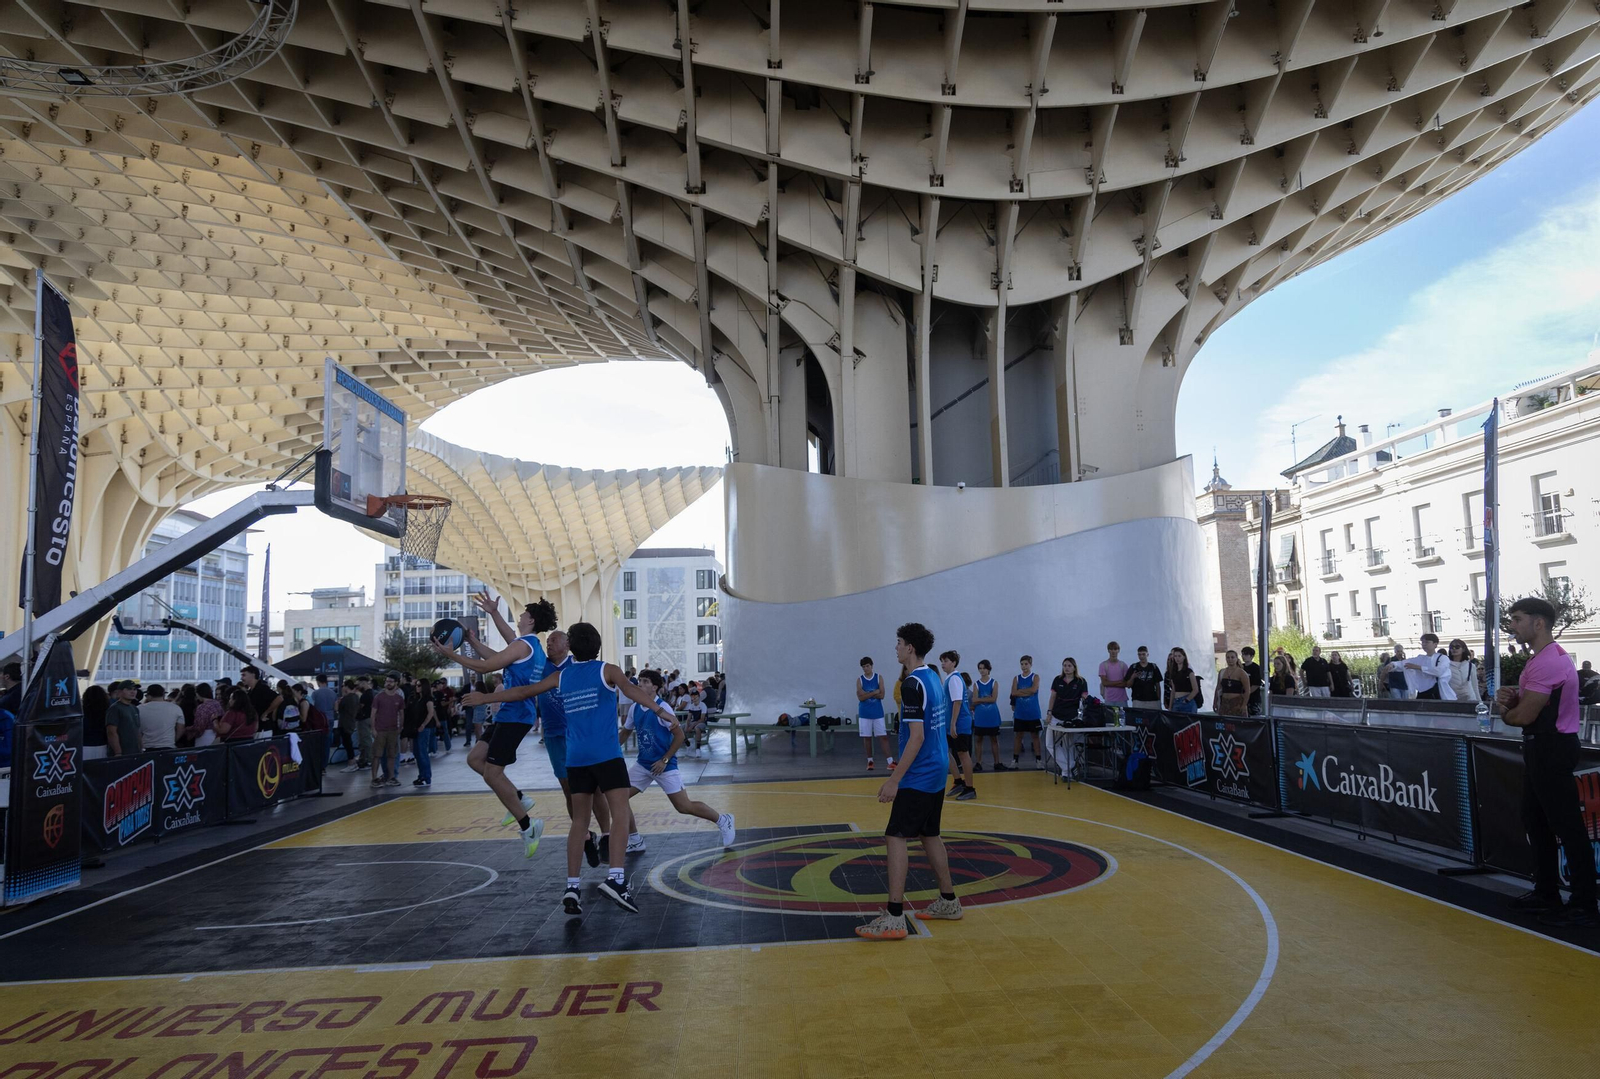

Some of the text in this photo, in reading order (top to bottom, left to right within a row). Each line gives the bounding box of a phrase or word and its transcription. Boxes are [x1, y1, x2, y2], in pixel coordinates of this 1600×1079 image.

[58, 393, 74, 456] ESPAÑA
[36, 783, 73, 798] CaixaBank
[106, 764, 152, 829] CANCHA
[1216, 778, 1250, 799] CaixaBank
[1321, 755, 1441, 813] CaixaBank
[164, 810, 201, 830] CaixaBank
[396, 981, 664, 1026] MUJER
